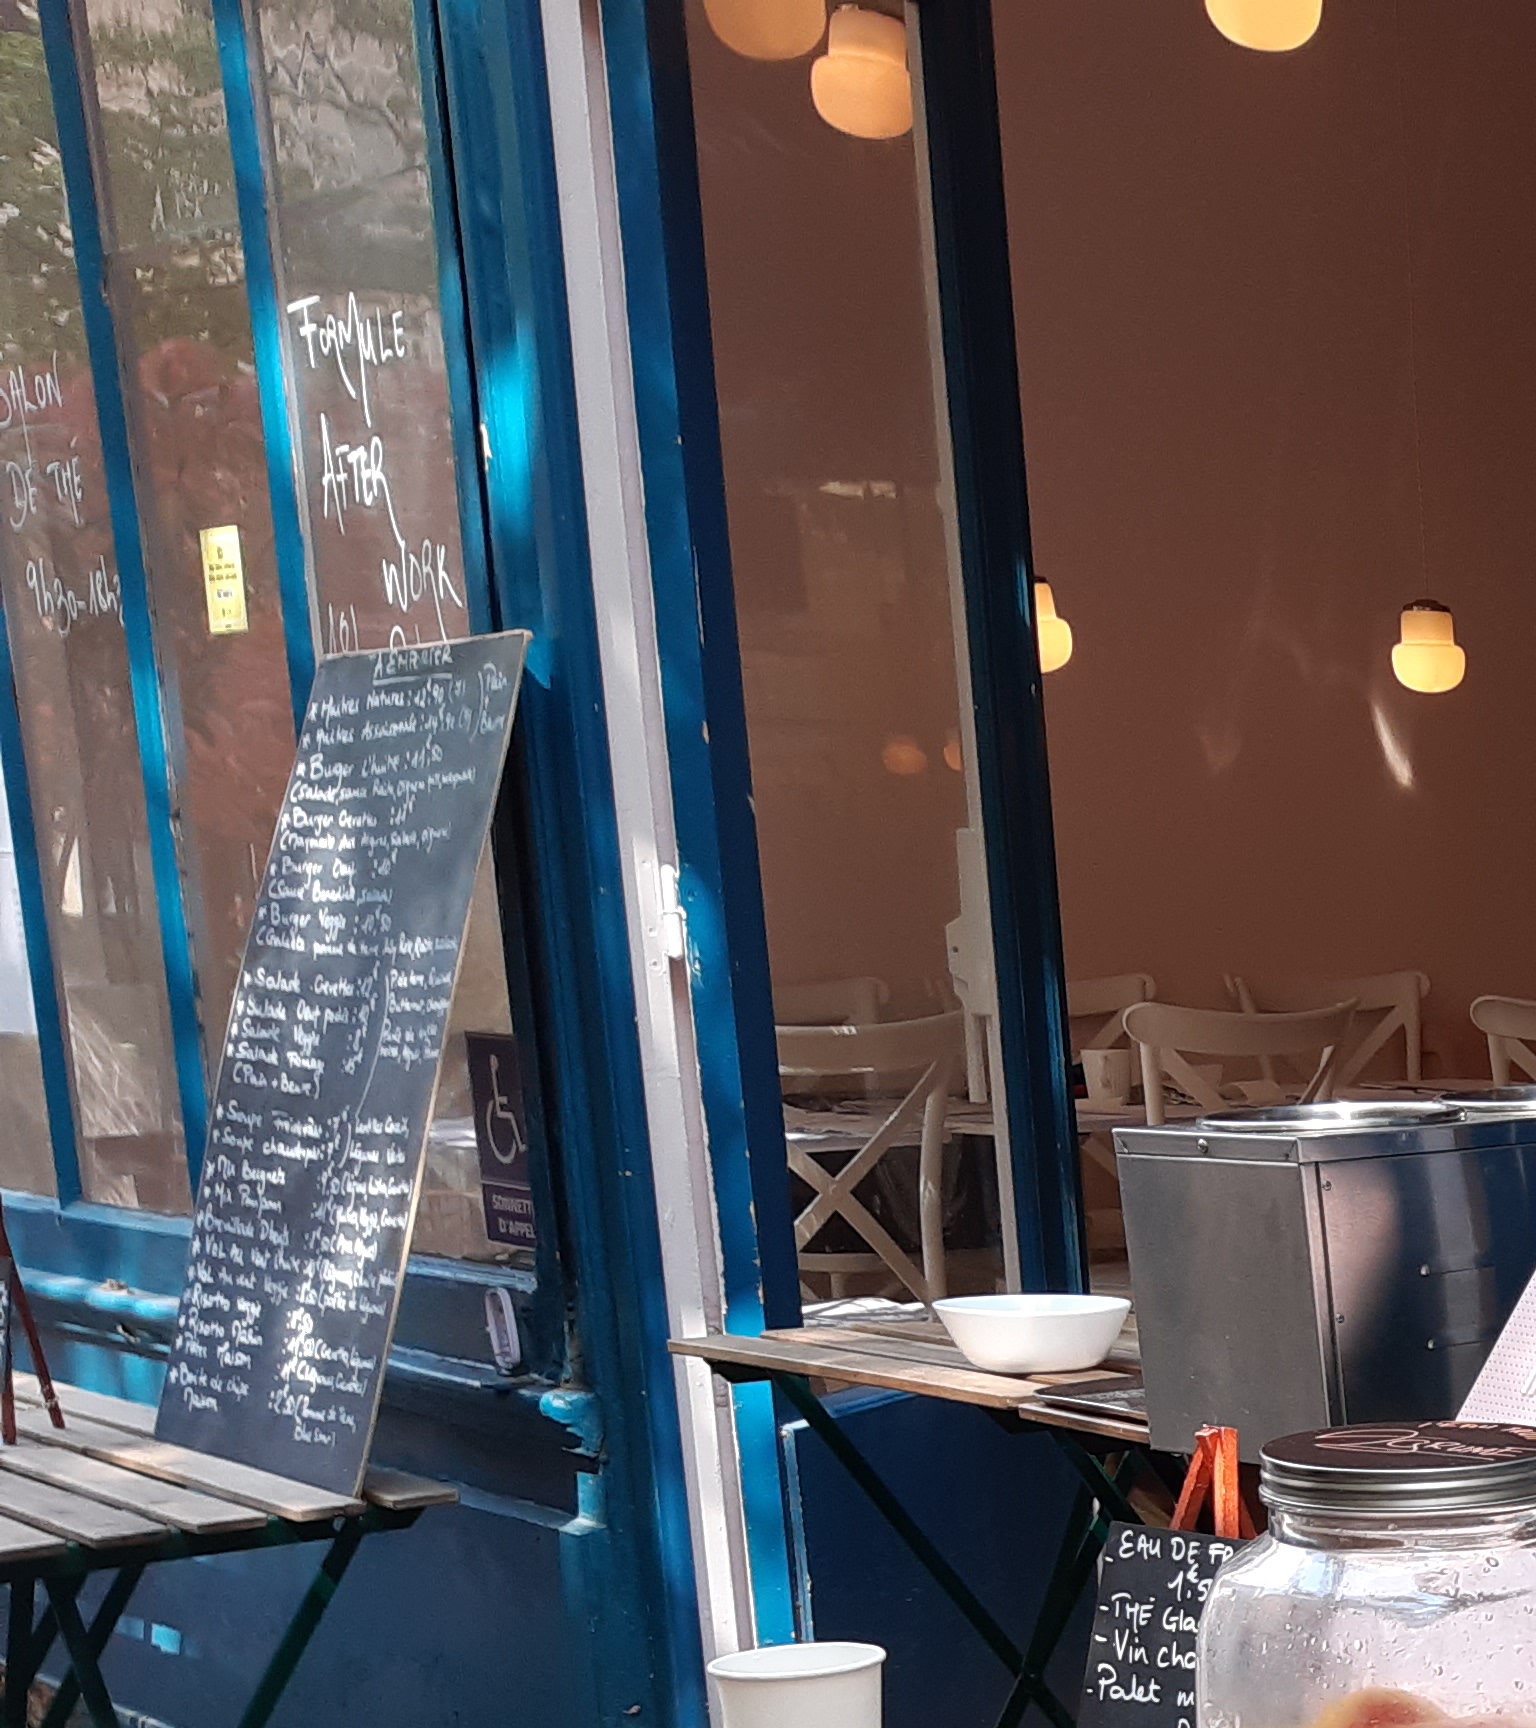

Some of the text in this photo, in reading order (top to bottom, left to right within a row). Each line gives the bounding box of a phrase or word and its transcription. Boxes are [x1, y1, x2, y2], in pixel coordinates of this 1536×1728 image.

[1119, 1529, 1161, 1560] EAU
[1171, 1536, 1200, 1564] DE
[1111, 1593, 1156, 1633] THÉ
[1113, 1629, 1149, 1665] Vin
[1098, 1663, 1161, 1703] Palet
